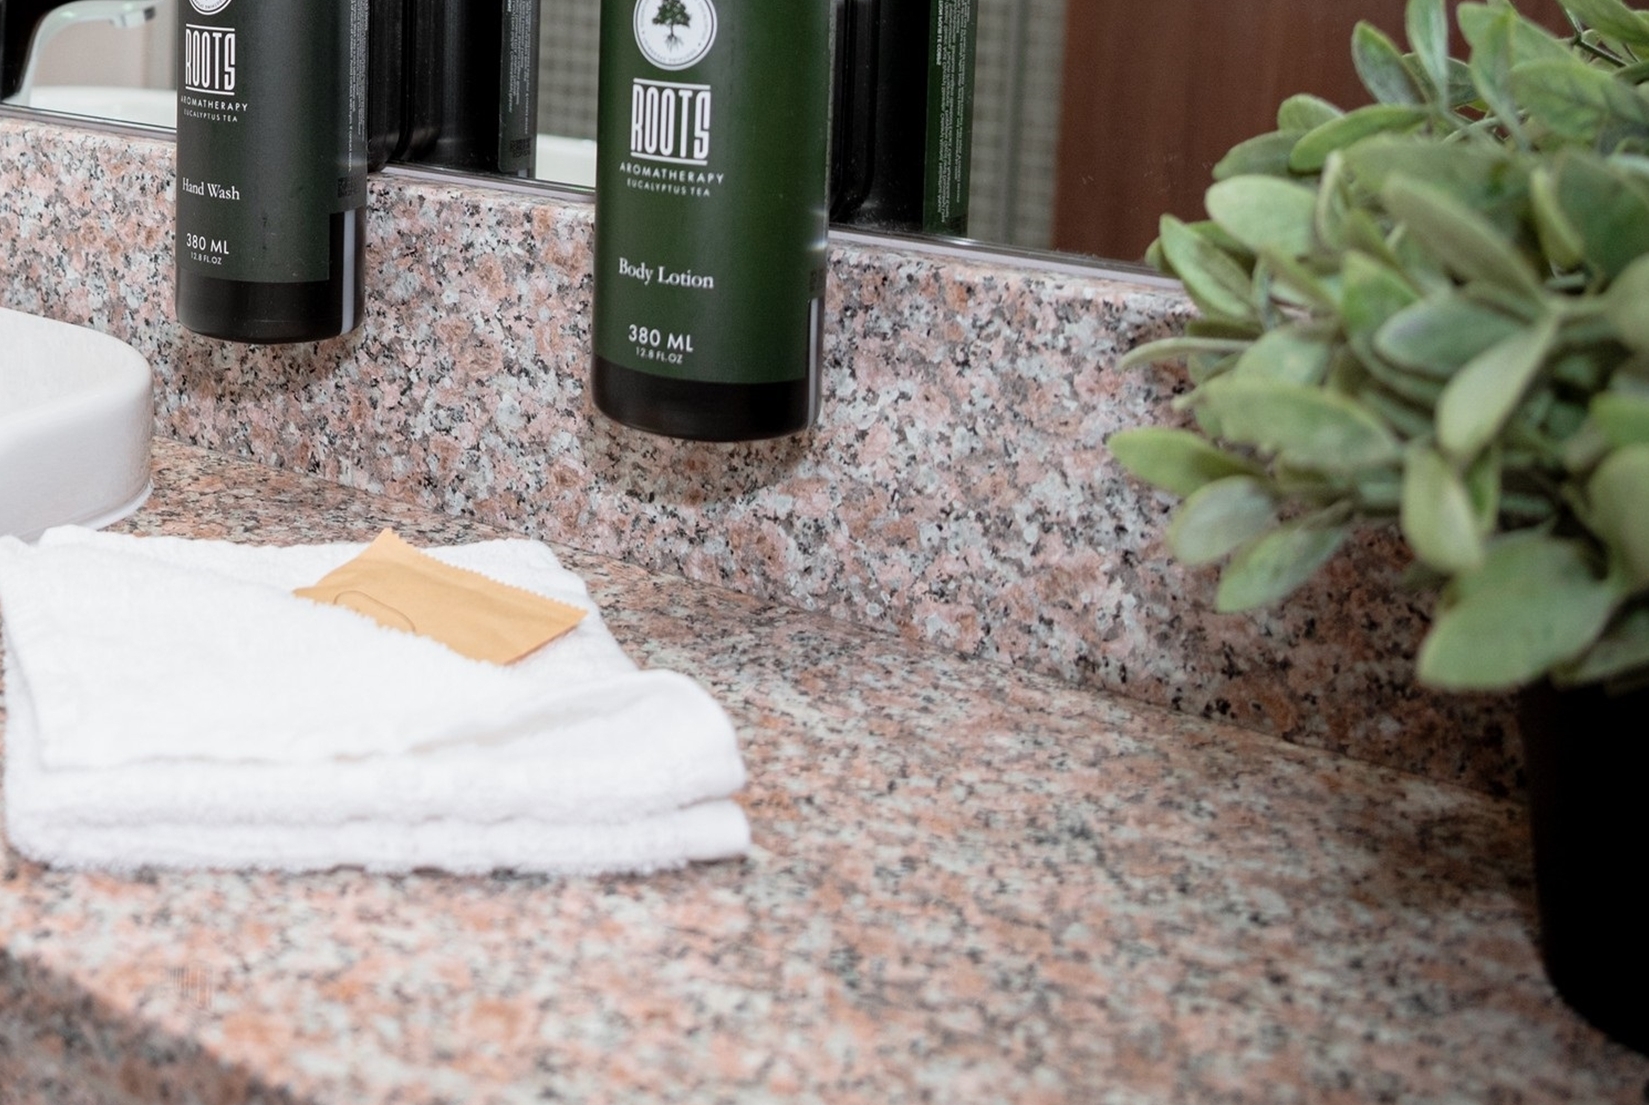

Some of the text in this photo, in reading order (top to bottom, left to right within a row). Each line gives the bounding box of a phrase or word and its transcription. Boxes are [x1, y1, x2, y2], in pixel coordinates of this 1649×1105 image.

[185, 28, 235, 90] ROOTS
[180, 95, 248, 111] AROMATHERAPY
[184, 108, 238, 122] EUCALYPTUS TEA
[630, 84, 711, 159] ROOTS
[619, 161, 724, 185] AROMATHERAPY
[182, 177, 240, 200] Hand Wash
[626, 177, 710, 197] EUCALYPTUS TEA
[186, 233, 229, 254] 380 ML
[619, 257, 714, 289] Body Lotion
[628, 324, 694, 353] 380 ML
[636, 346, 654, 359] 12.8
